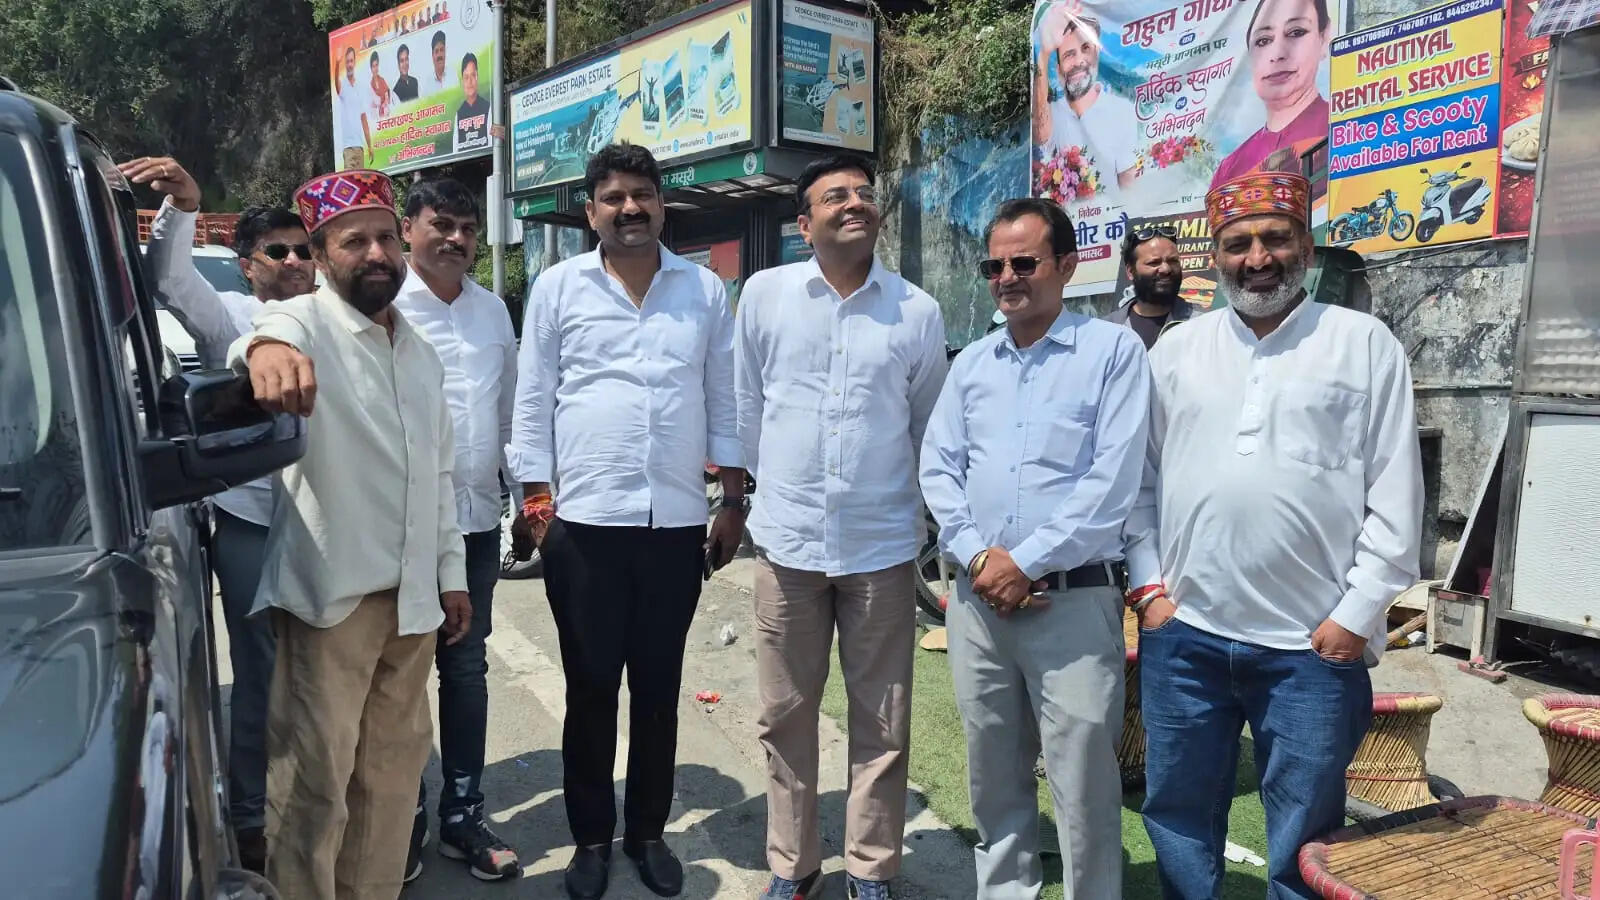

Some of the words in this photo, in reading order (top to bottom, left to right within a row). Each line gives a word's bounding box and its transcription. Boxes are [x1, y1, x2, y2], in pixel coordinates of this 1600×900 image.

[1122, 8, 1178, 48] राहुल
[1175, 42, 1211, 63] आगमन
[1213, 38, 1228, 51] पर
[1357, 28, 1454, 74] NAUTIYAL
[521, 86, 545, 109] GEORGE
[545, 79, 570, 101] EVEREST
[570, 72, 588, 90] PARK
[588, 64, 611, 85] ESTATE
[1135, 71, 1184, 121] हार्दिक
[1186, 57, 1235, 105] स्वागत
[1331, 77, 1403, 113] RENTAL
[1408, 52, 1490, 95] SERVICE
[1332, 121, 1378, 148] Bike
[1381, 114, 1400, 137] &
[1404, 95, 1488, 132] Scooty
[1330, 141, 1408, 174] Available
[1411, 135, 1440, 157] For
[1443, 124, 1487, 150] Rent
[671, 166, 696, 186] मसूरी
[1181, 257, 1204, 269] PEN
